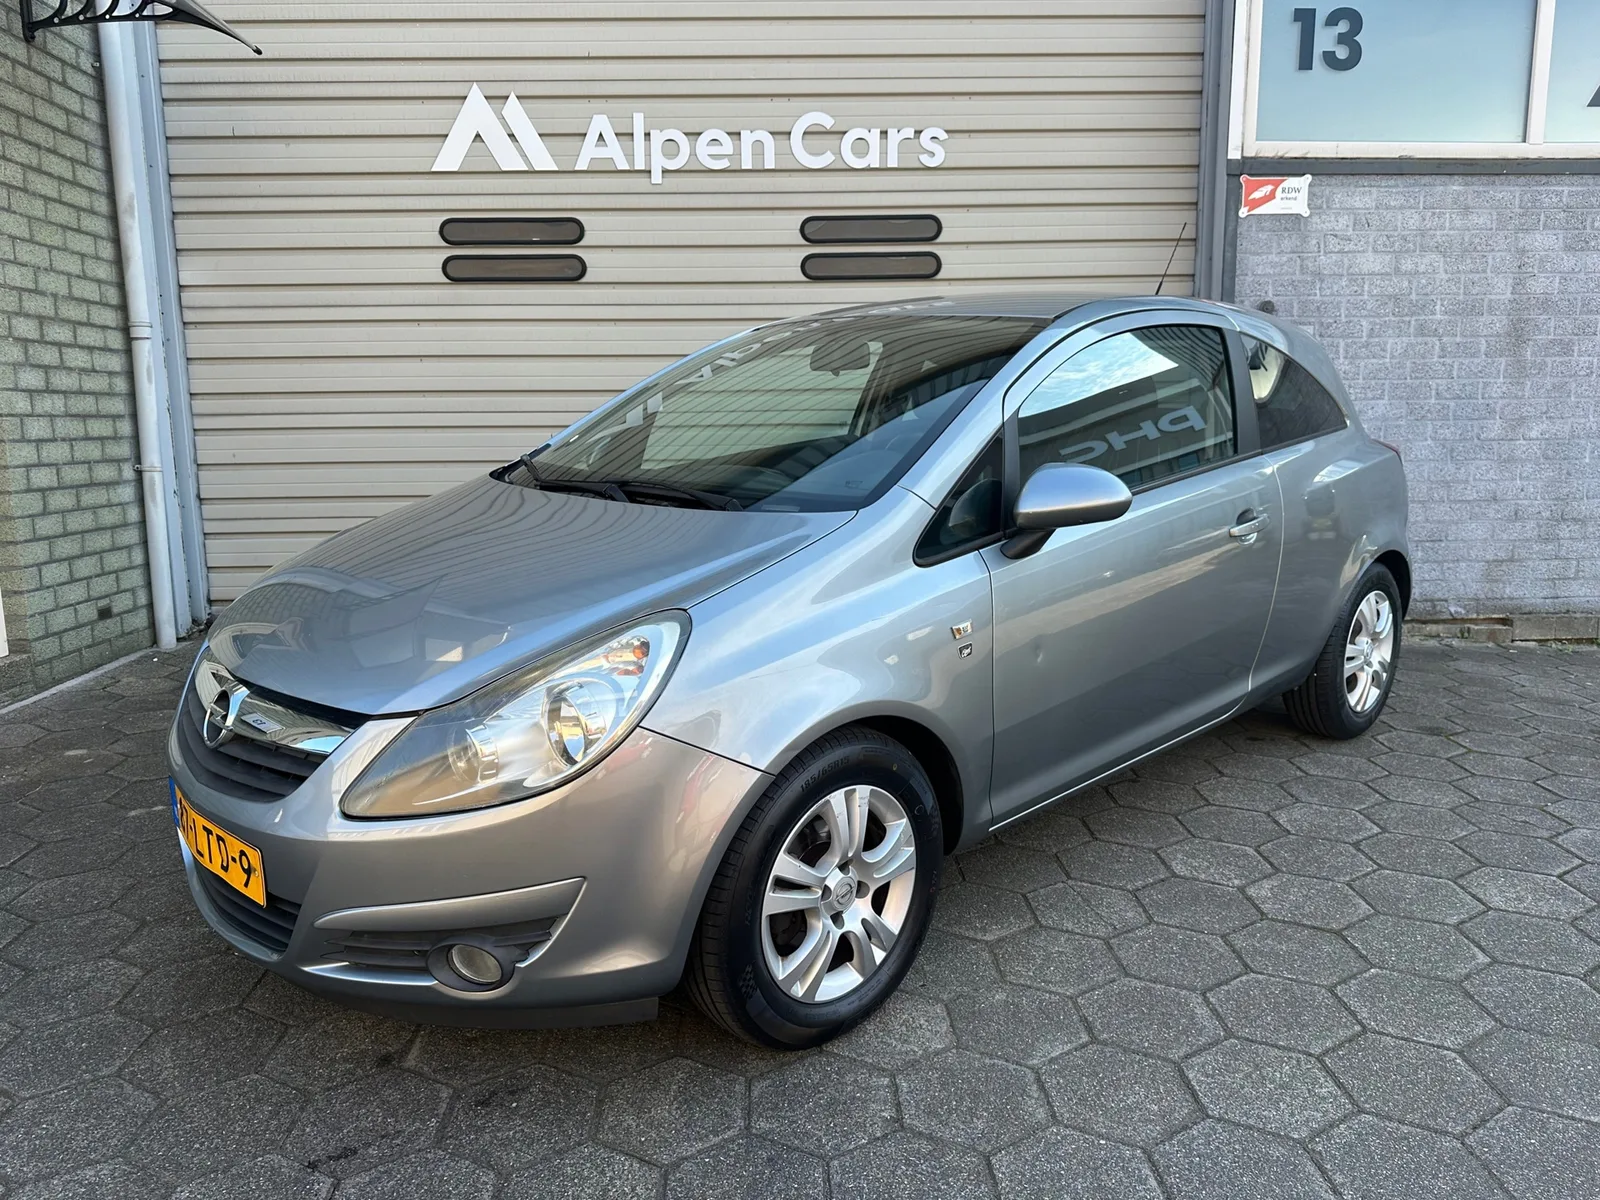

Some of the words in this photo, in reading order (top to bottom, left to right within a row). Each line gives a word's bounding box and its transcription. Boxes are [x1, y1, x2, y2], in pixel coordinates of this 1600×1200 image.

[1293, 7, 1363, 72] 13
[574, 112, 776, 185] Alpen
[790, 111, 949, 169] Cars
[1281, 186, 1303, 195] RDW
[800, 755, 850, 793] 185/65R15
